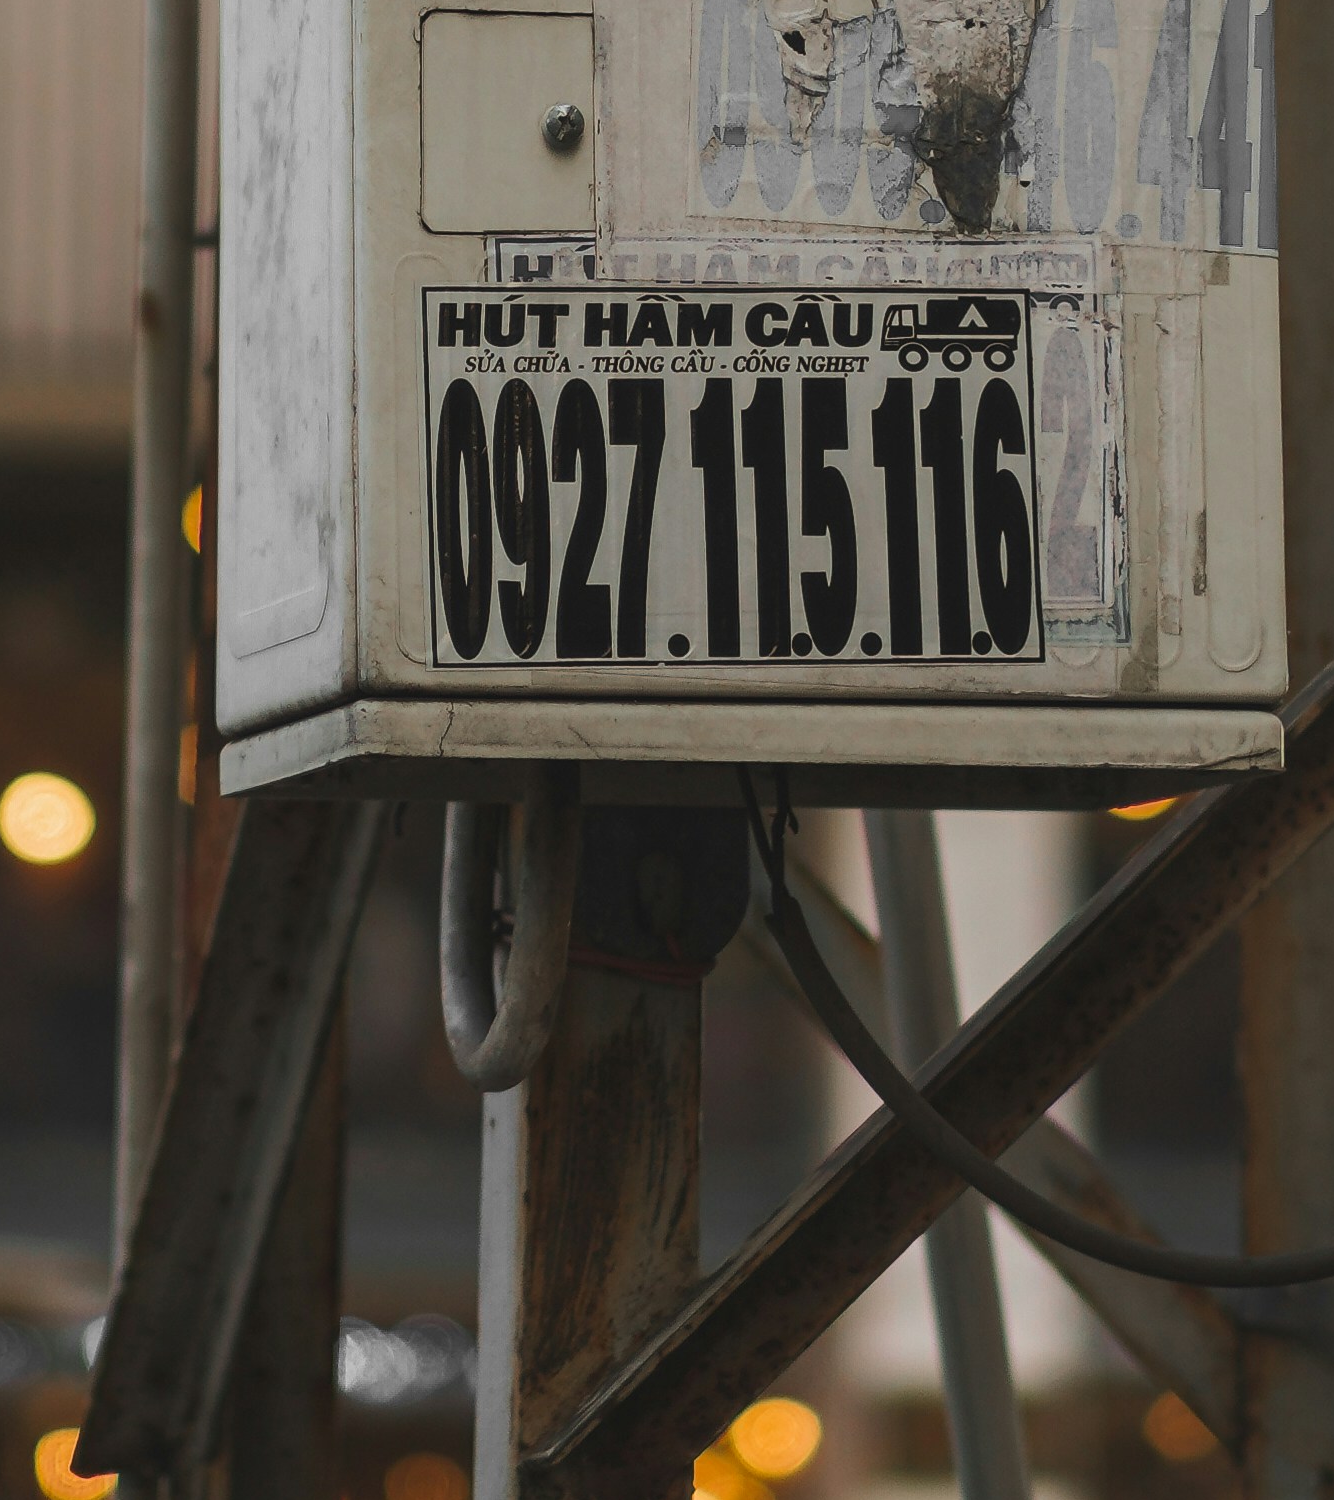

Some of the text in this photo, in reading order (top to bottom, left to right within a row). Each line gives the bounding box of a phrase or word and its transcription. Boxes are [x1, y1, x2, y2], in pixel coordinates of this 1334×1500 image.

[437, 294, 874, 348] HÚT HẦM CẦU
[465, 351, 506, 373] SỬA
[513, 350, 571, 373] CHỮA
[592, 350, 665, 374] THÔNG
[671, 350, 716, 374] CẦU
[733, 349, 790, 374] CỐNG
[795, 355, 870, 378] NGHẸT
